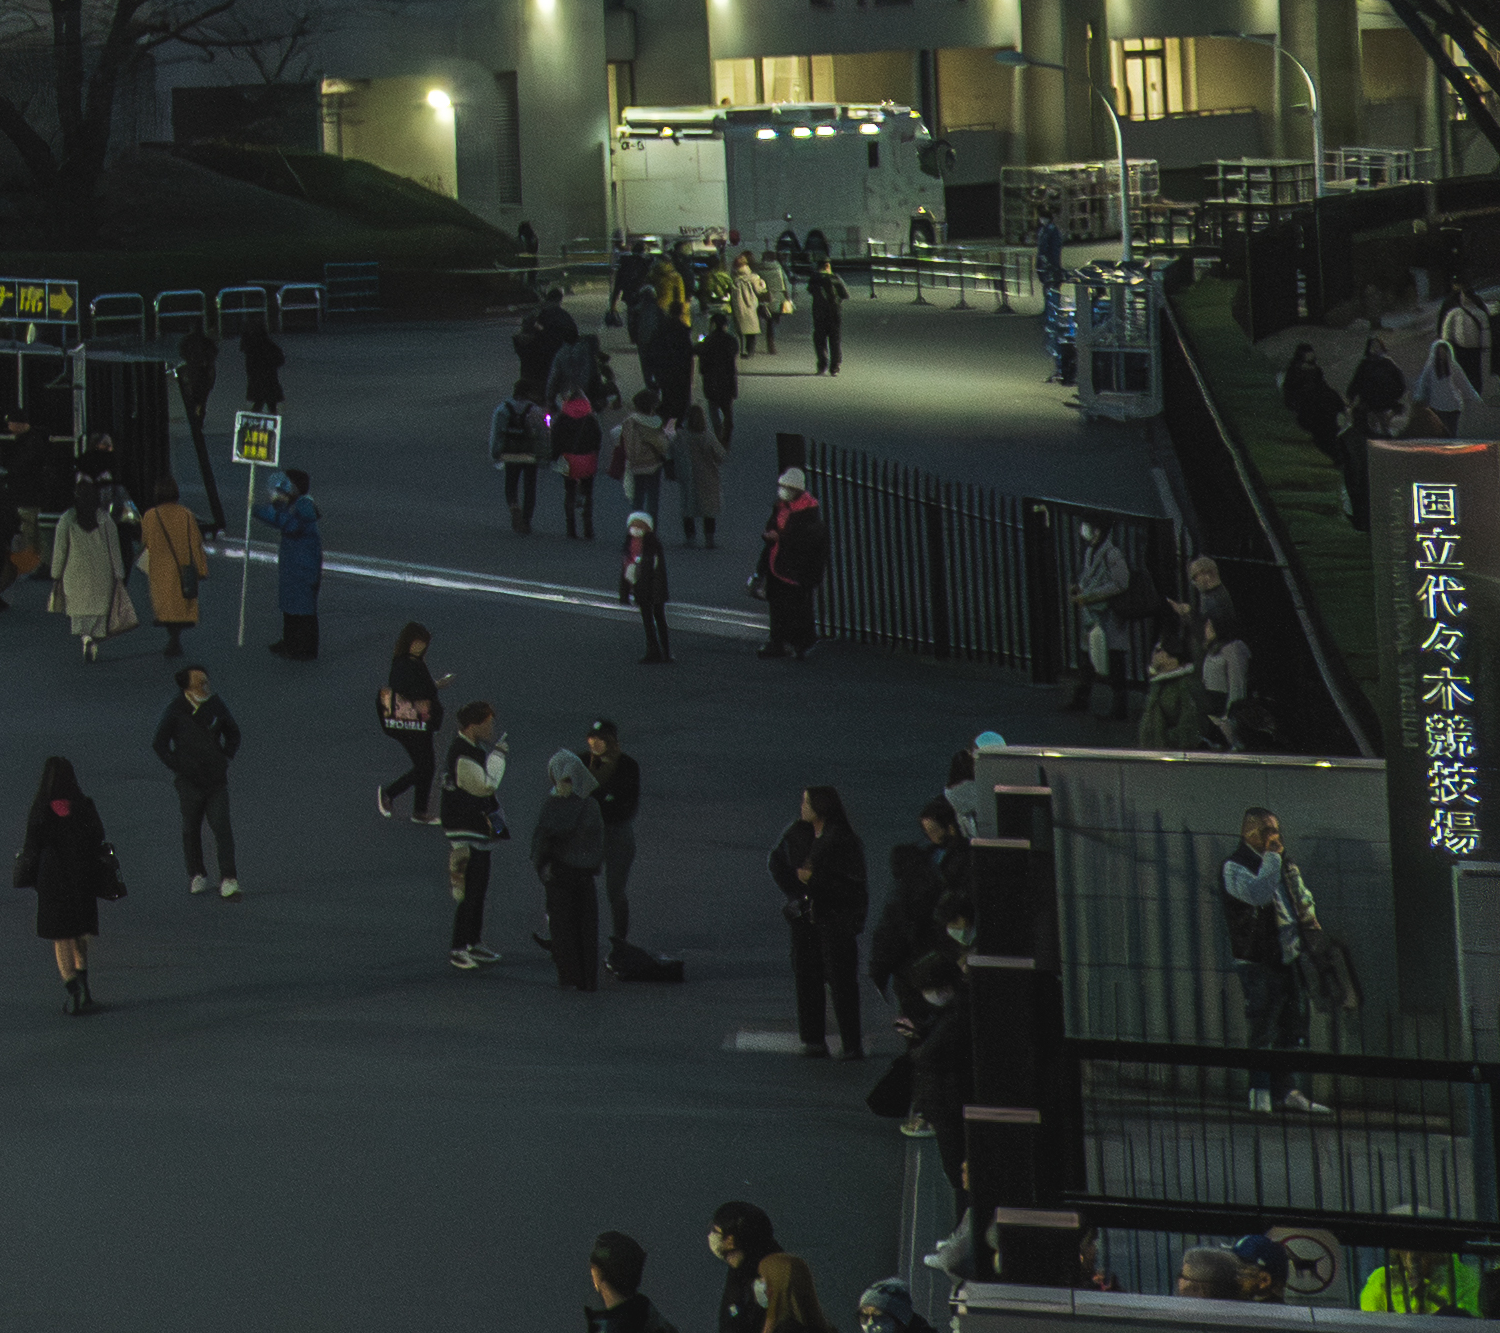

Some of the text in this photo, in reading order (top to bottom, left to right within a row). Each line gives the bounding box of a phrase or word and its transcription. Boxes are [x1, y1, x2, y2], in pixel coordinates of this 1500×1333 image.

[1398, 663, 1420, 748] STADIUM
[1412, 482, 1482, 854] 国立代々木競技場
